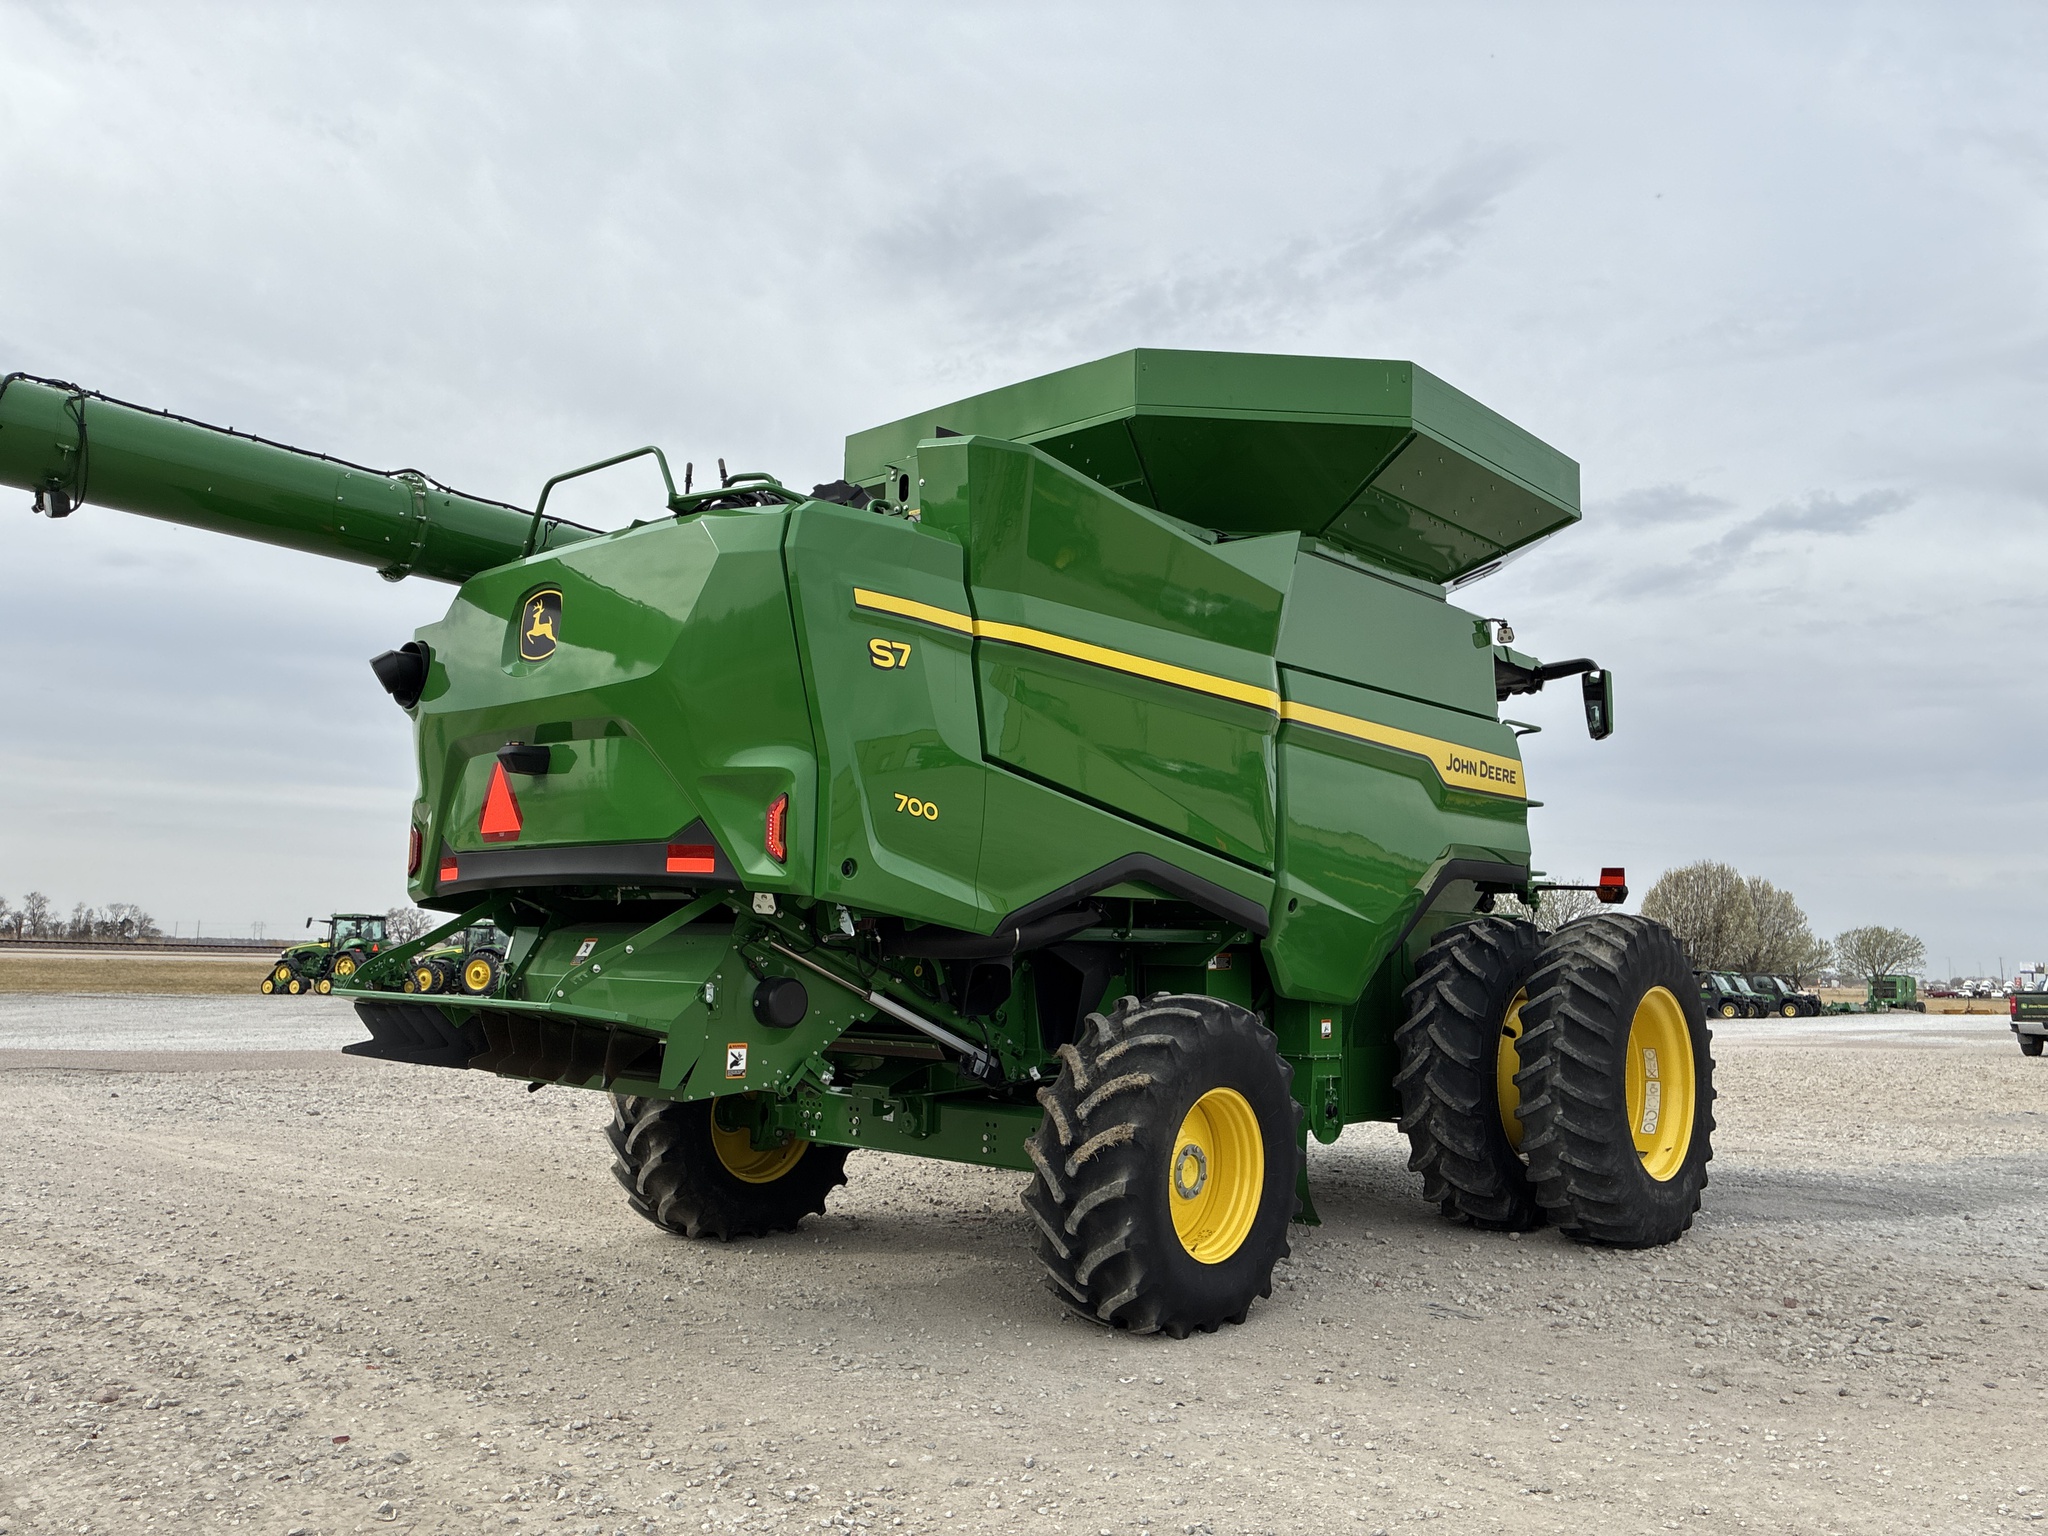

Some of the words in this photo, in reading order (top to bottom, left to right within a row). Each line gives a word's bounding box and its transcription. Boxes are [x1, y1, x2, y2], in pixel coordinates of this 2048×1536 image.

[868, 638, 912, 669] S7
[1446, 753, 1477, 776] JOHN
[1480, 760, 1516, 784] DEERE
[894, 792, 939, 821] 700
